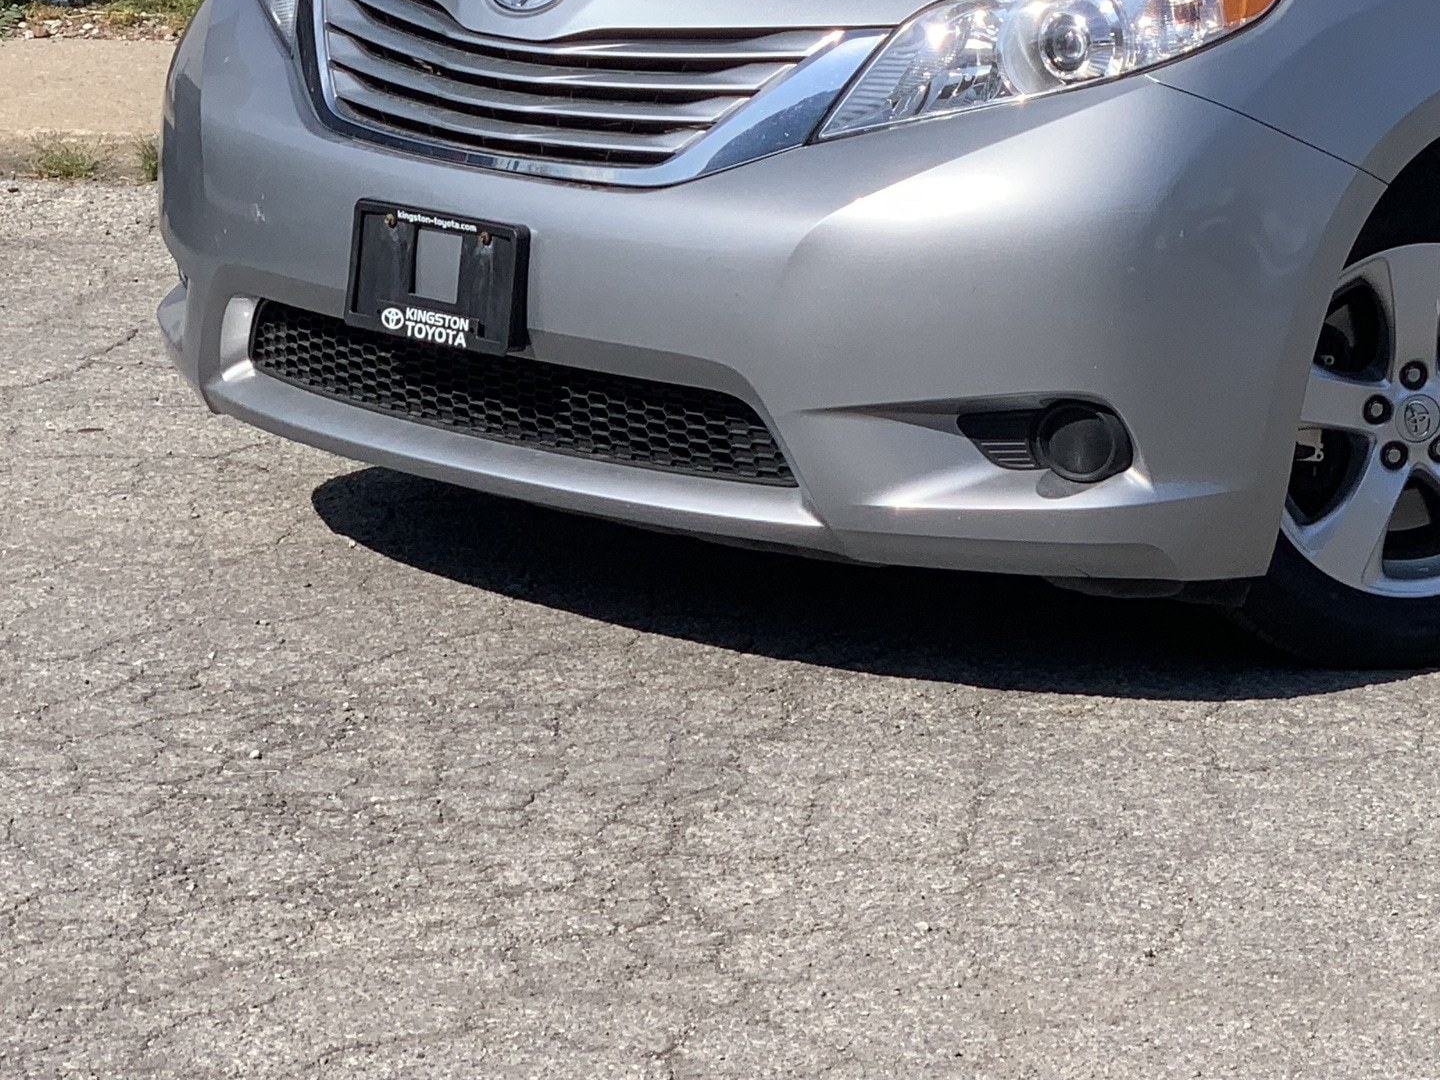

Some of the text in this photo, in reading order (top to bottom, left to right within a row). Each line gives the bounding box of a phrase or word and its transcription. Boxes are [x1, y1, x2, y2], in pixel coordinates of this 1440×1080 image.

[397, 210, 477, 232] kingston-toyota.com
[405, 307, 469, 331] KINGSTON
[405, 321, 467, 347] TOYOTA
